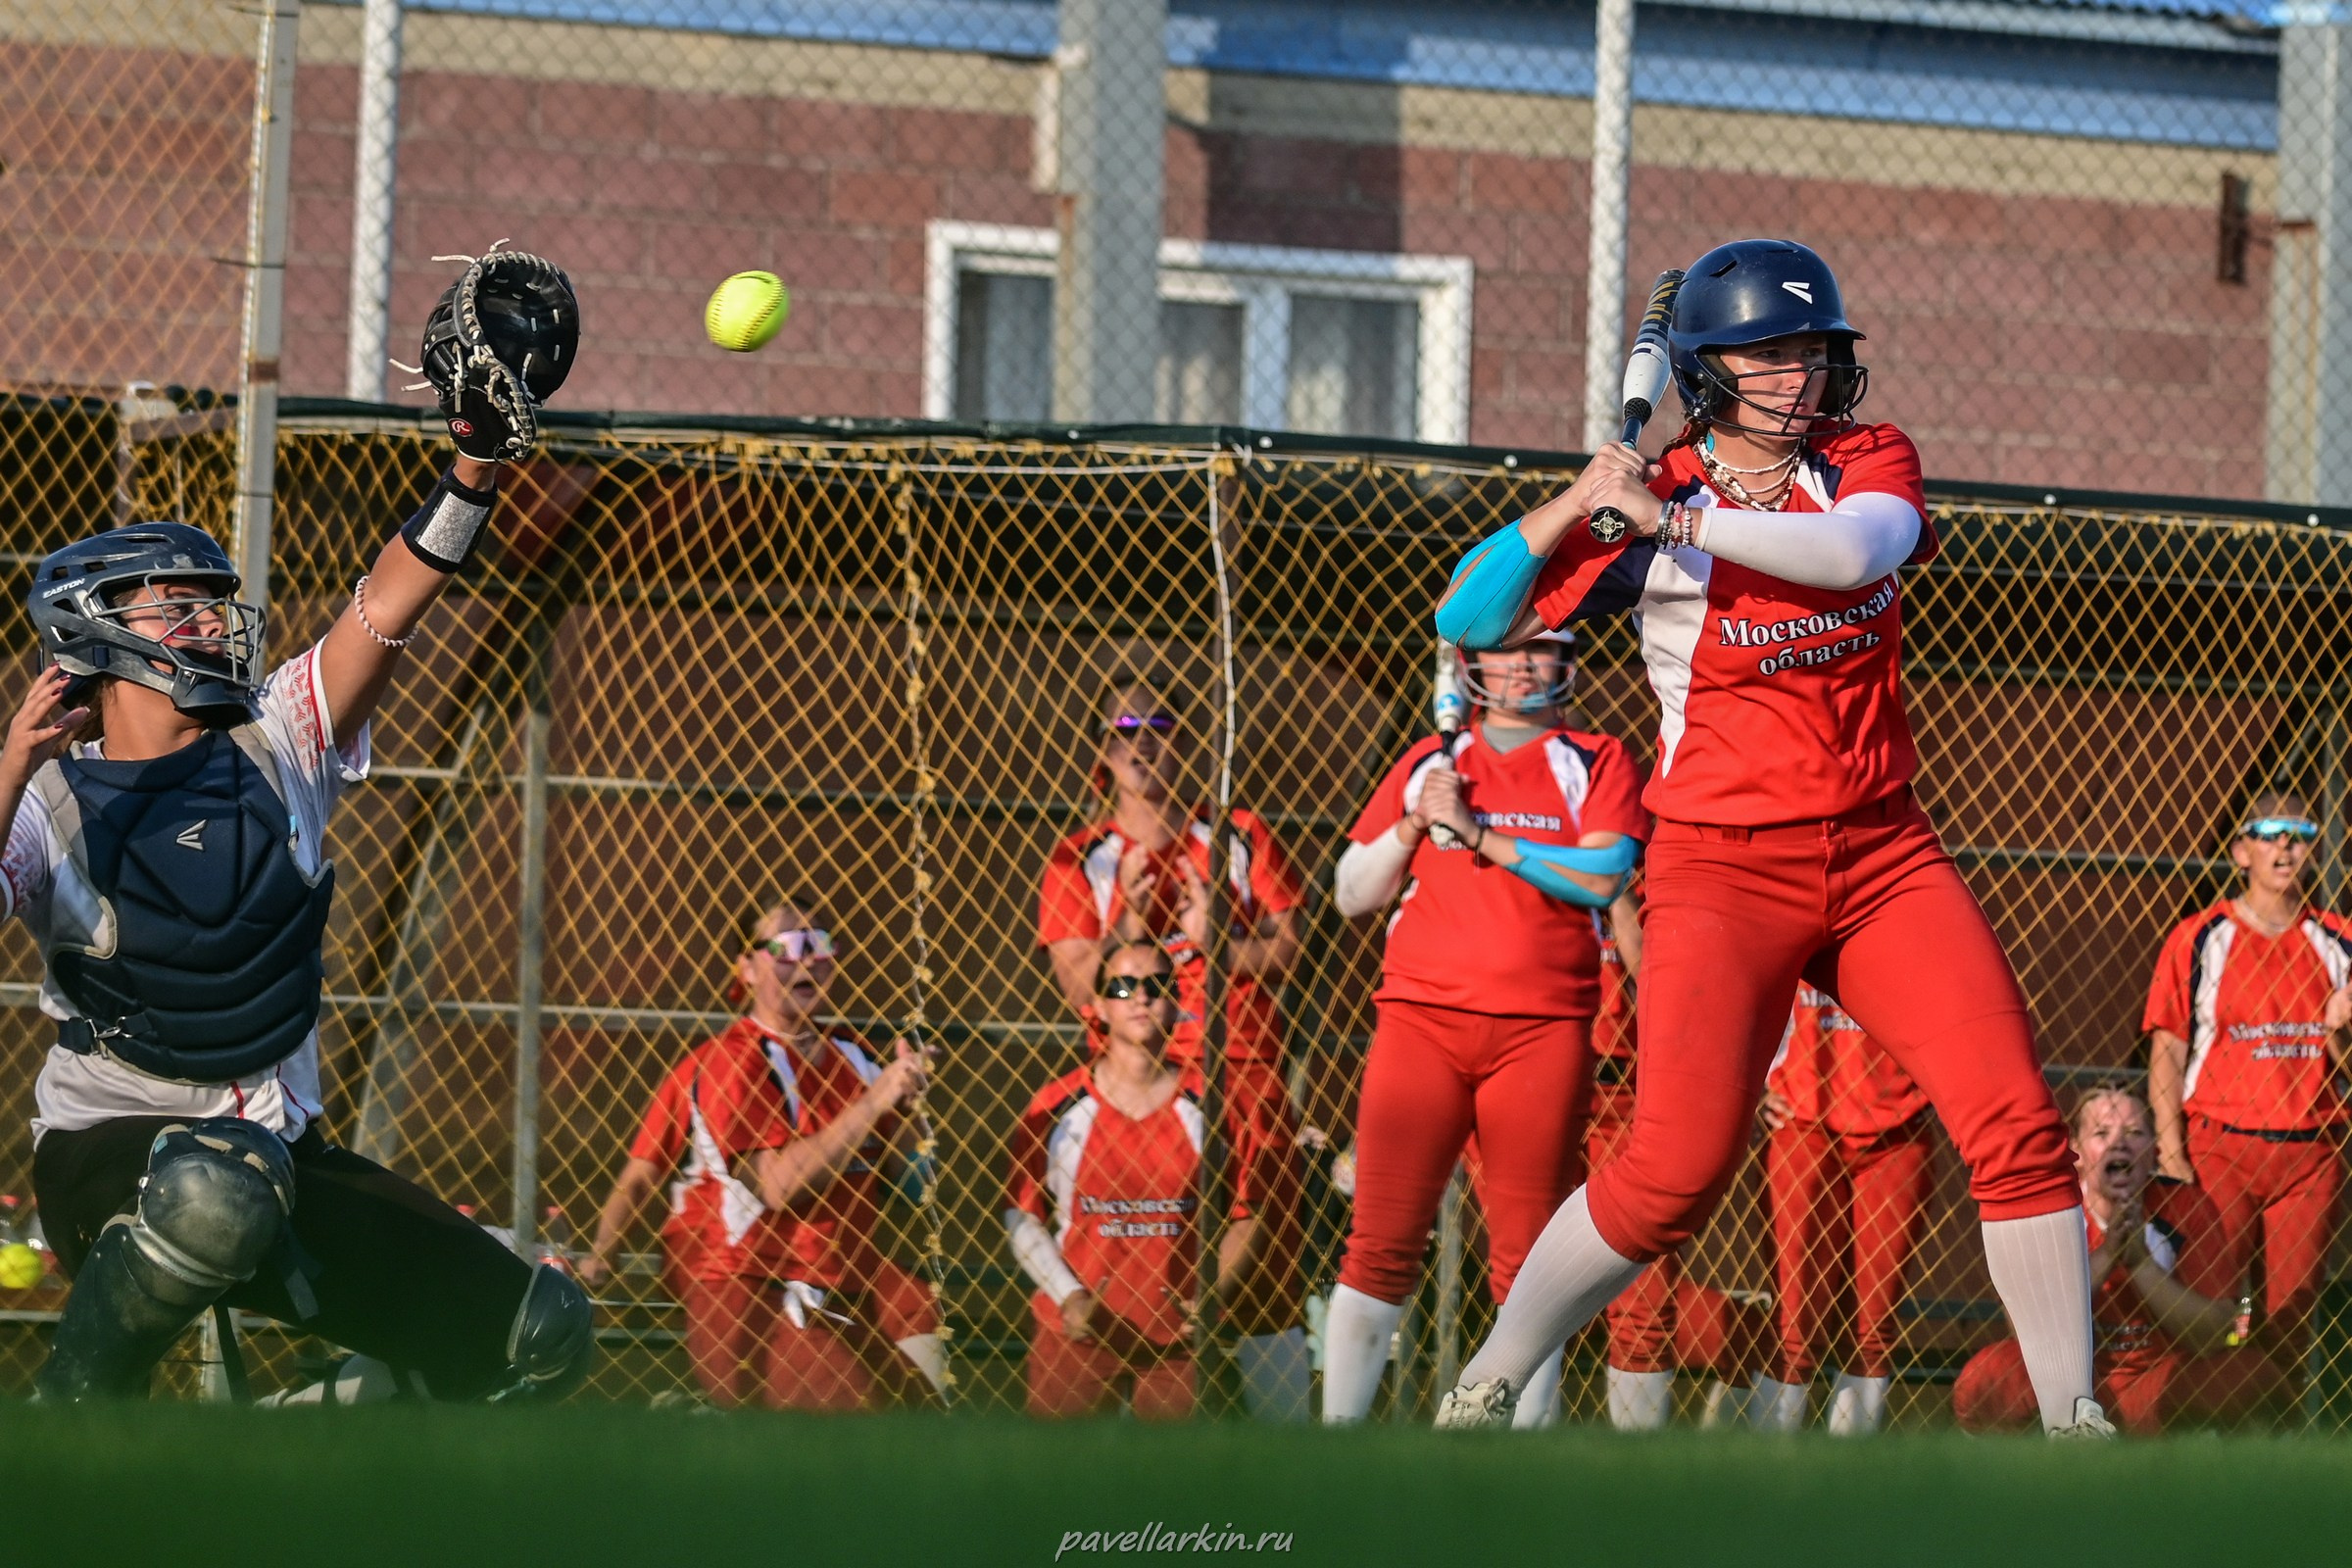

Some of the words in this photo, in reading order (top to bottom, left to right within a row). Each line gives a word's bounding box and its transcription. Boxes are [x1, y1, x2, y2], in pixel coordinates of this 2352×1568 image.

[42, 577, 86, 600] EASTON
[1718, 580, 1895, 648] Московская
[1758, 630, 1881, 676] область
